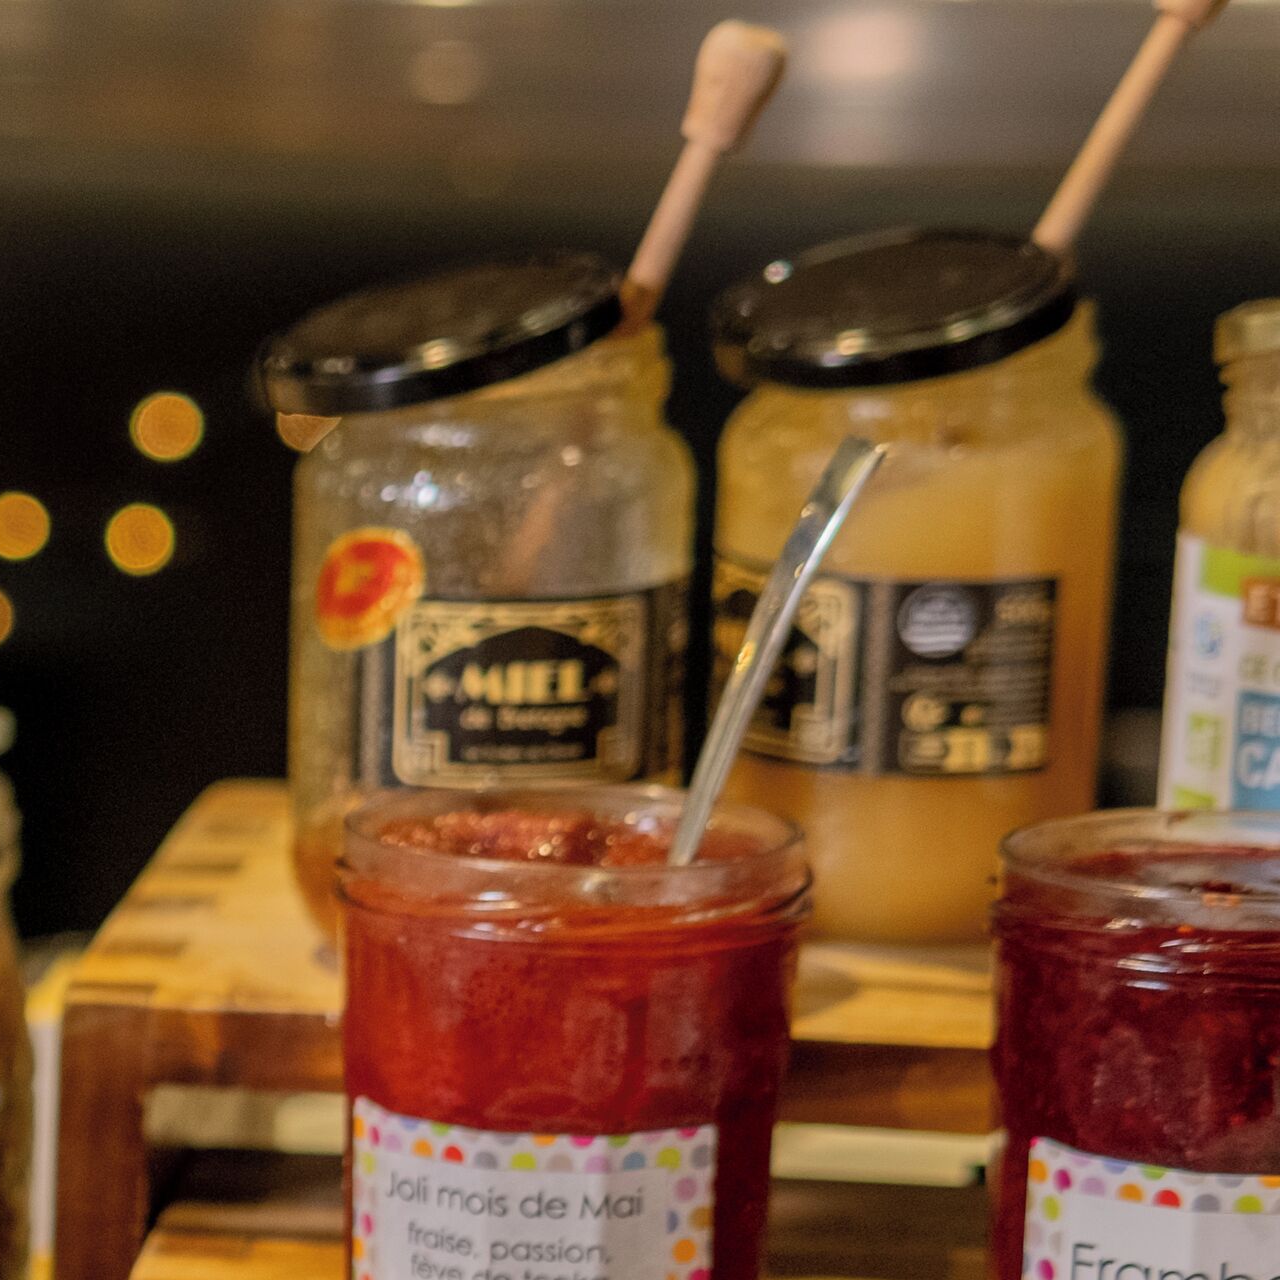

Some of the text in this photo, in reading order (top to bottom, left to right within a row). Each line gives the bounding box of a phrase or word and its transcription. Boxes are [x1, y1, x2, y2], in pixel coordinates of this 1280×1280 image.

[385, 1171, 645, 1220] Joli mois de Mai
[407, 1220, 612, 1265] fraise, passion,
